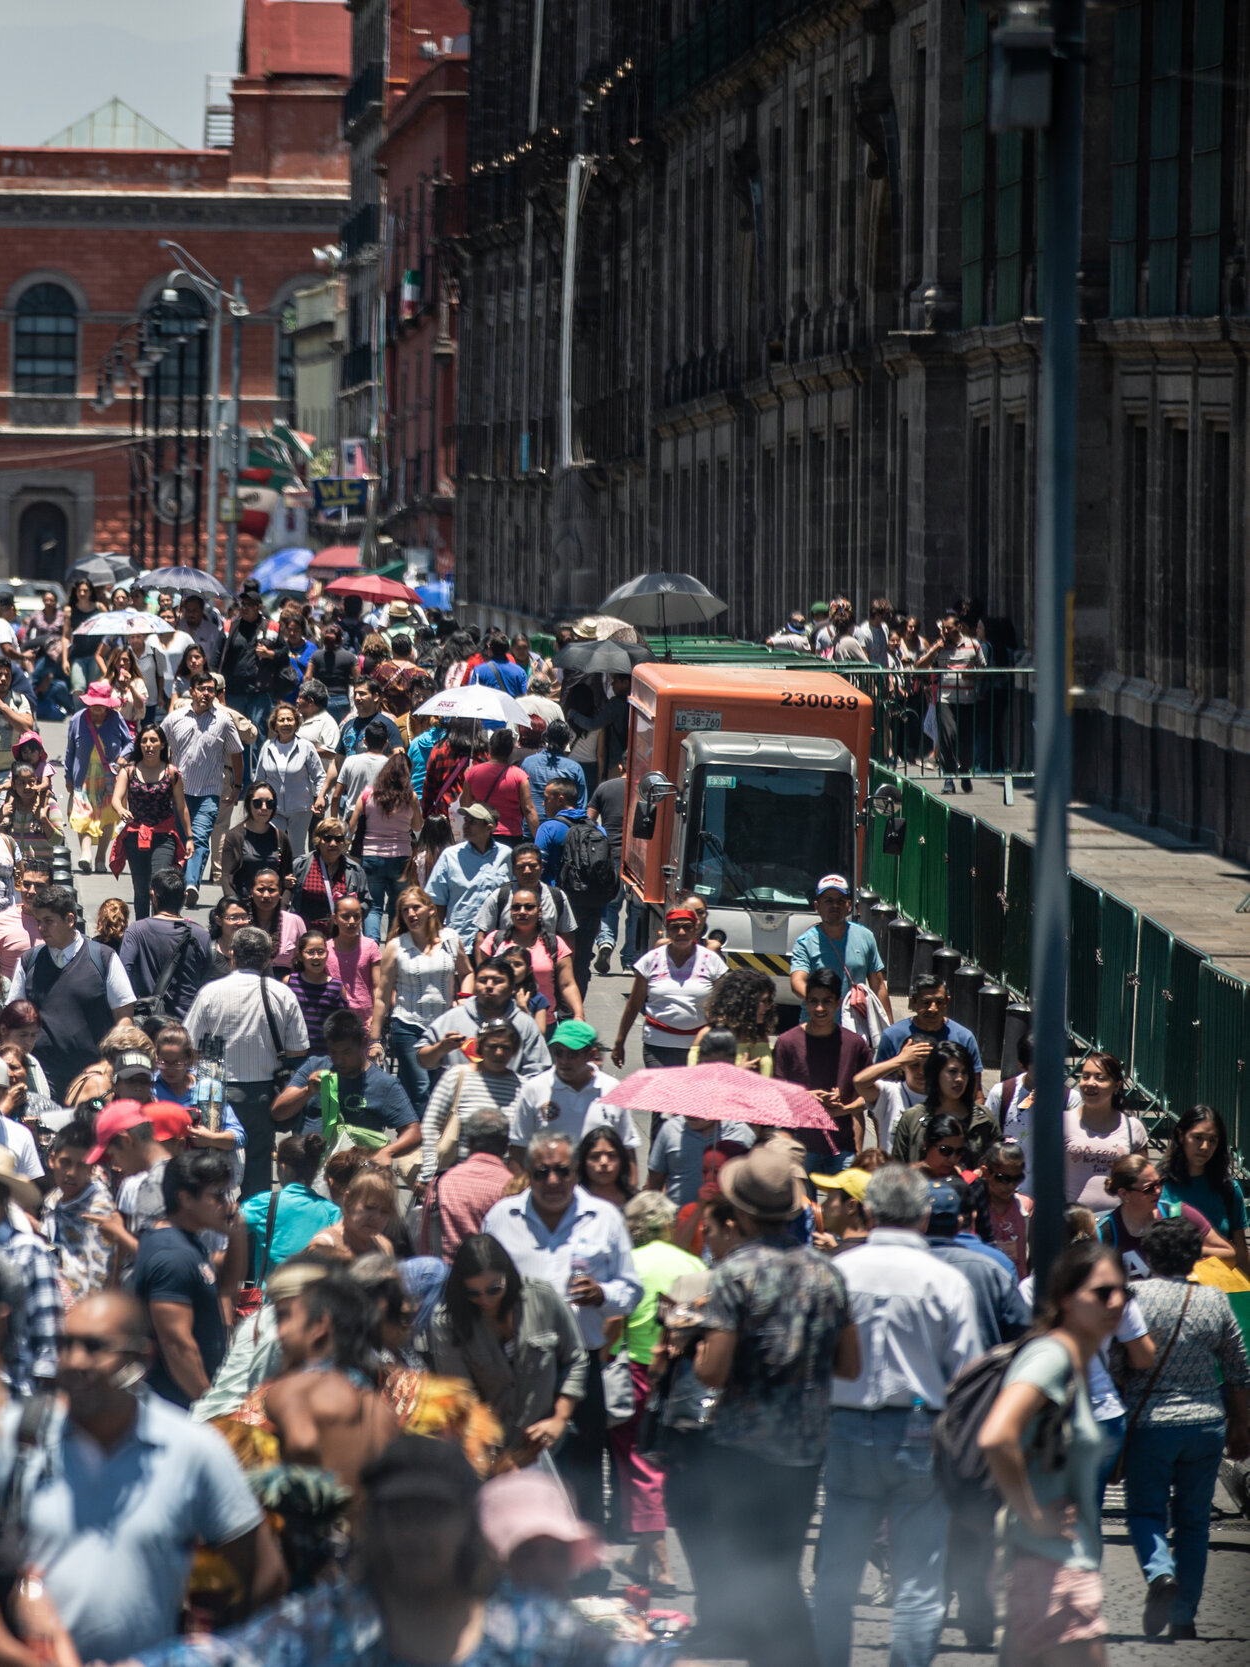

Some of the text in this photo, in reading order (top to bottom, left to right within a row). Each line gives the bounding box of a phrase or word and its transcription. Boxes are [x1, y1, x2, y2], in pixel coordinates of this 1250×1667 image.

[317, 480, 362, 500] WC
[780, 691, 859, 711] 230039
[676, 715, 720, 728] LB-38-760
